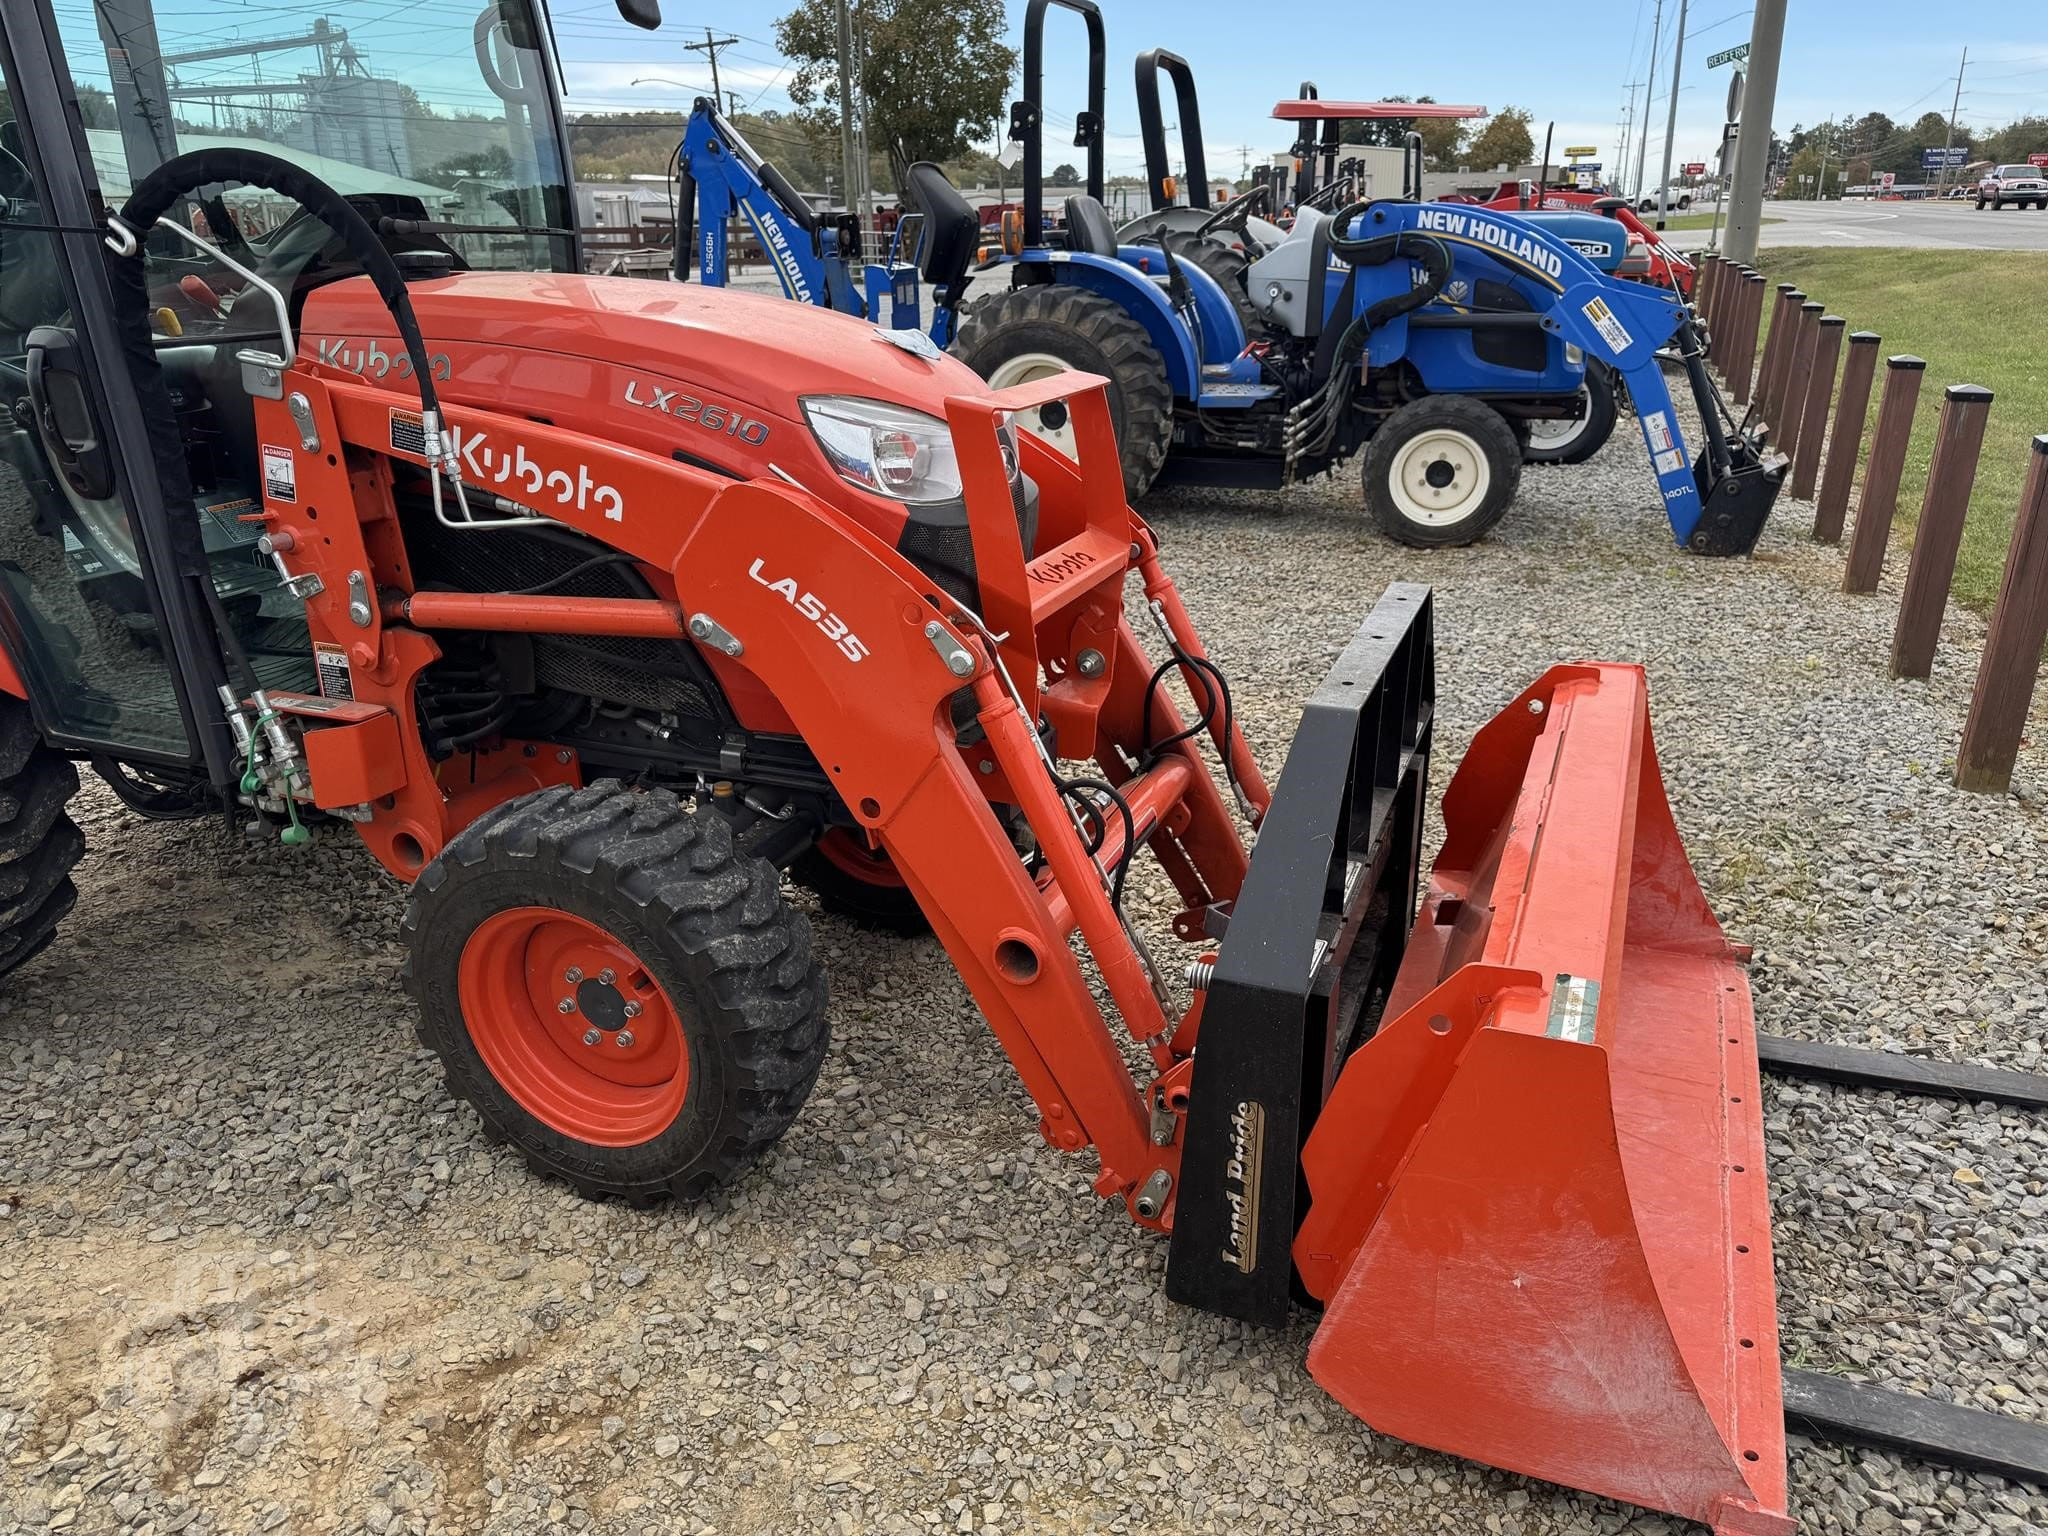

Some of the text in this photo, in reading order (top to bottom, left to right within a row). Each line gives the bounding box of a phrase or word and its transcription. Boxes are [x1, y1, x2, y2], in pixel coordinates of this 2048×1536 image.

[1708, 45, 1748, 68] REDFERN
[760, 212, 789, 249] NEW
[1417, 210, 1464, 234] NEW
[1468, 221, 1562, 279] HOLLAND
[319, 337, 451, 380] Kuboa
[624, 380, 770, 446] LX2610
[269, 448, 292, 459] DANGER
[452, 425, 624, 523] Kubota
[1664, 485, 1695, 501] 140TL
[1026, 551, 1097, 584] Kubota
[748, 557, 871, 662] LA535
[1222, 1102, 1257, 1274] Land Pride
